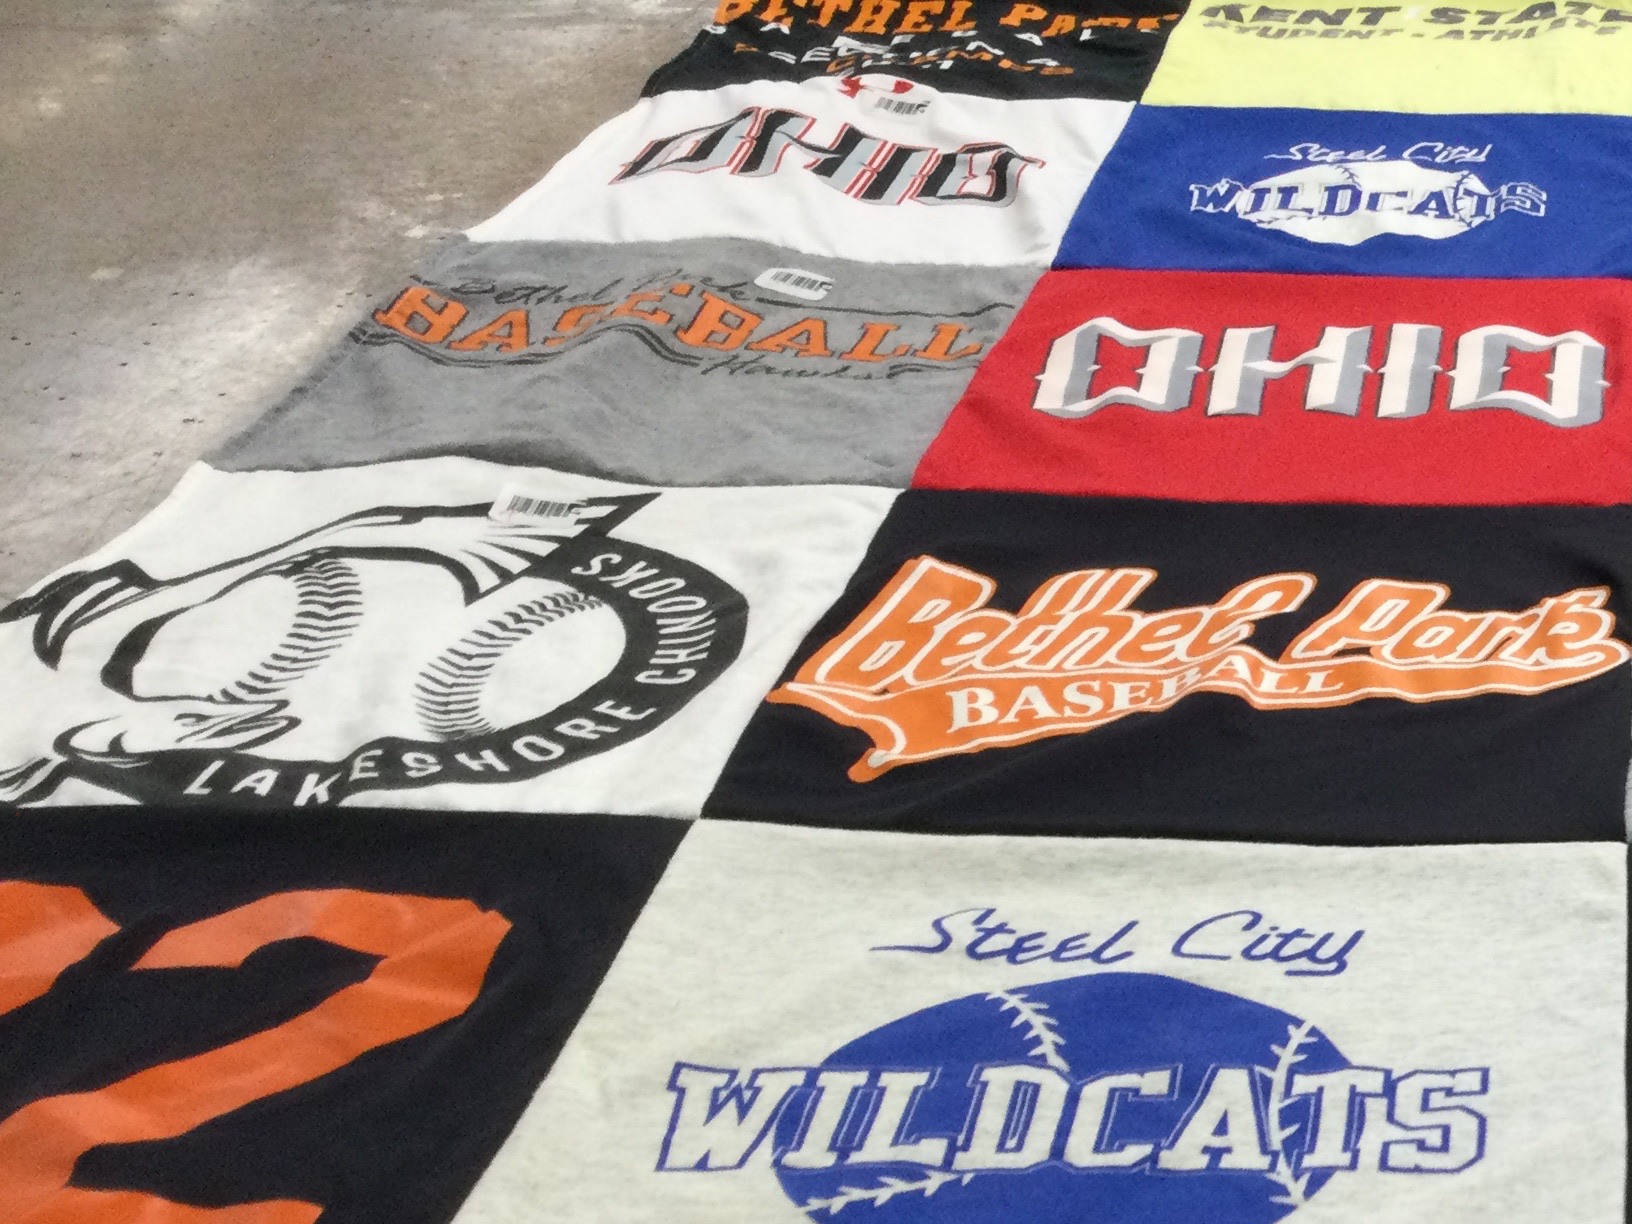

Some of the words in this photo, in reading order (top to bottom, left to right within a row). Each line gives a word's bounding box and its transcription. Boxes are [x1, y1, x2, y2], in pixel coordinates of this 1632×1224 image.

[1033, 316, 1613, 429] OHIO
[184, 698, 656, 806] LAKESHORE
[573, 553, 719, 687] CHINOOKS
[806, 556, 1318, 692] Bethel
[1279, 578, 1632, 668] Park
[869, 907, 1142, 965] Steel
[1170, 909, 1367, 977] City
[655, 1061, 1492, 1175] WILDCATS
